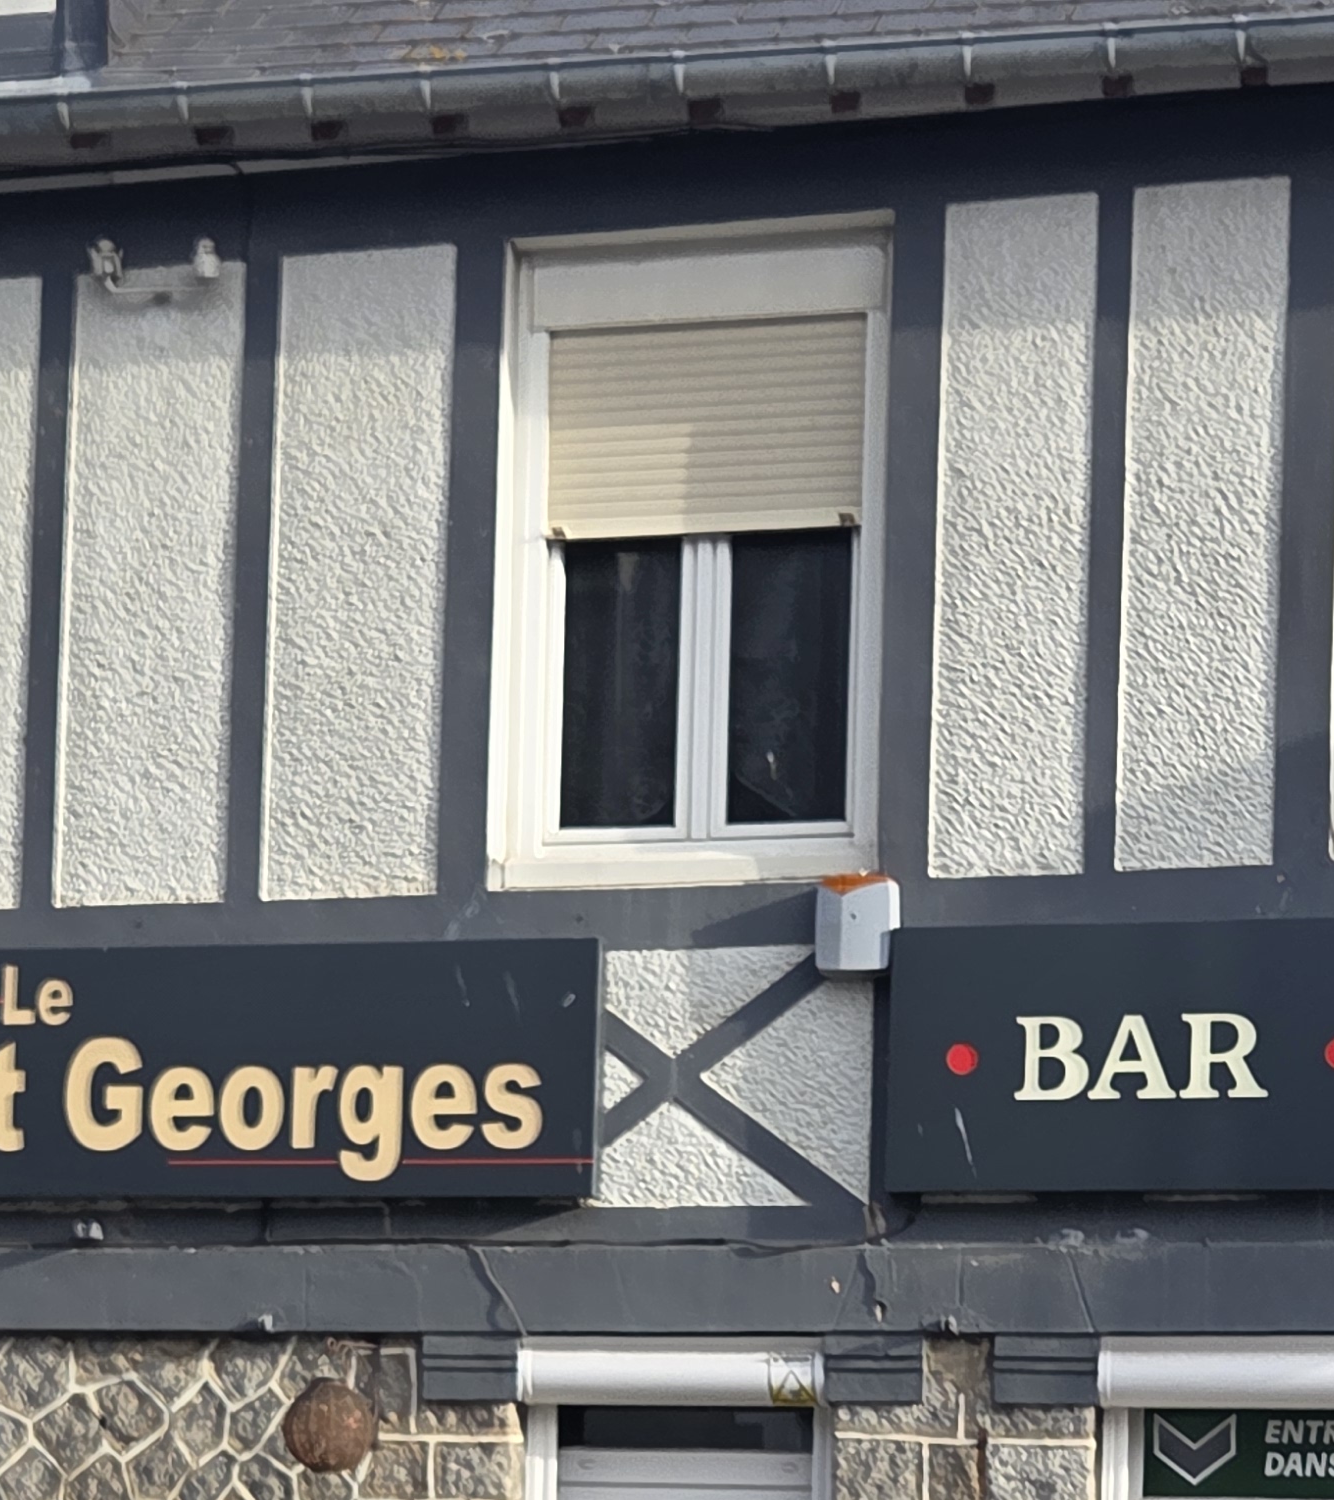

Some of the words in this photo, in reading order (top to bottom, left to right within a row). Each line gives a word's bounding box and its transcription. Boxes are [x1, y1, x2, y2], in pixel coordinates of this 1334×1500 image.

[0, 964, 74, 1026] Le
[1013, 1012, 1269, 1101] BAR
[64, 1035, 544, 1182] Georges
